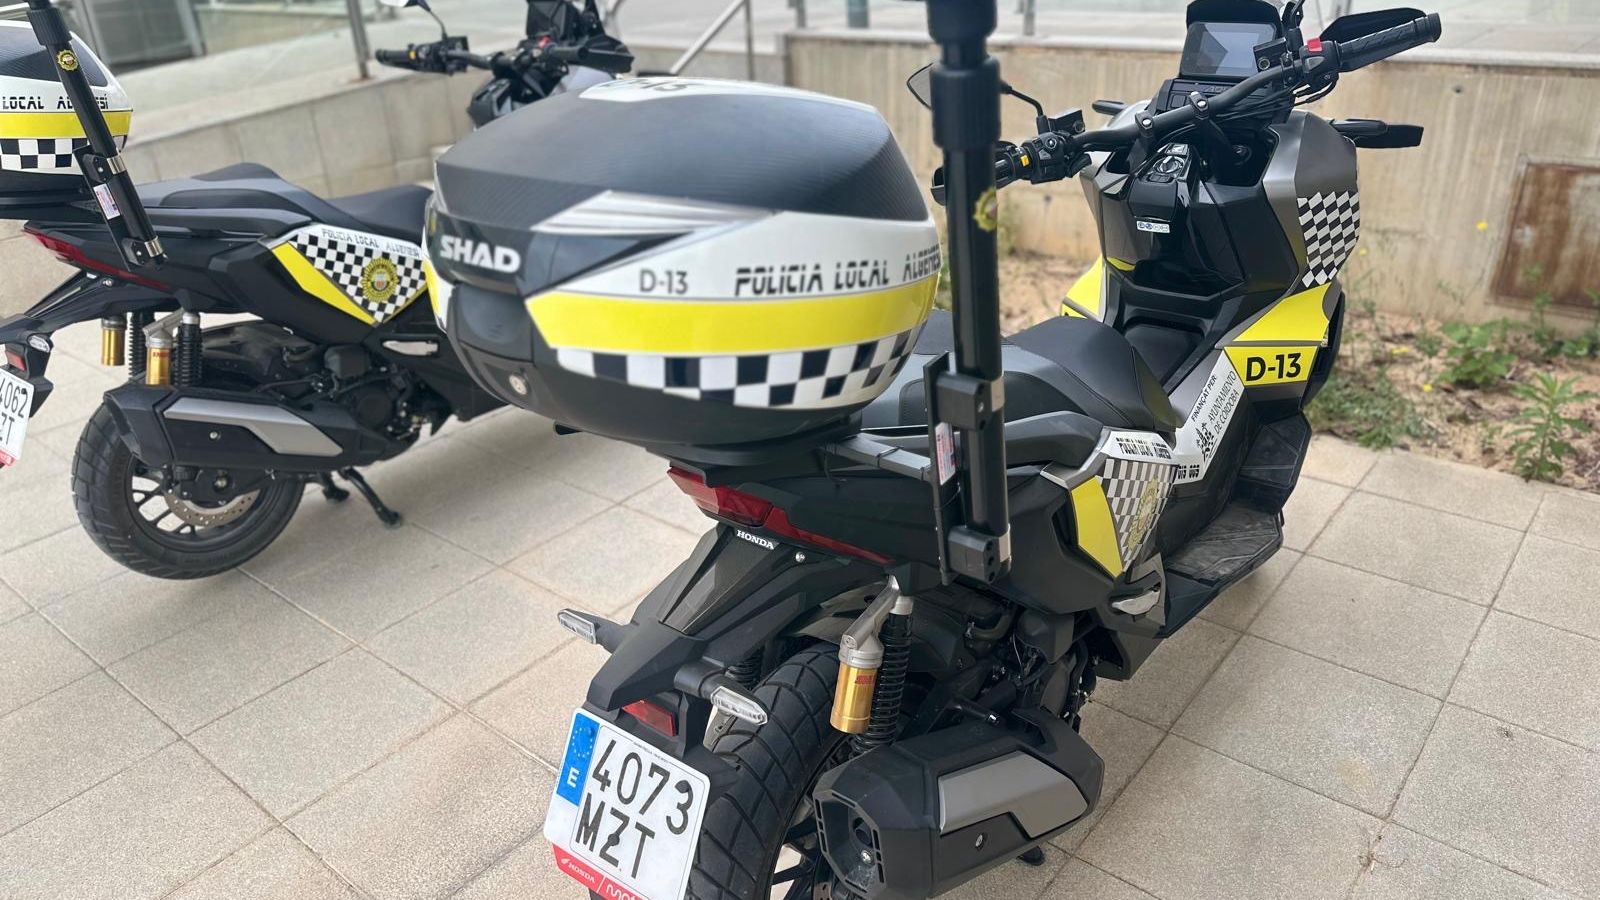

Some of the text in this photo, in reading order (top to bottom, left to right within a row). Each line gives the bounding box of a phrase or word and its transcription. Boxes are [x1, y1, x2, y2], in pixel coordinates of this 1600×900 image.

[3, 96, 44, 110] LOCAL
[440, 234, 521, 274] SHAD
[639, 268, 688, 295] D-13
[735, 263, 823, 297] POLICIA
[834, 259, 889, 290] LOCAL
[1245, 352, 1302, 382] D-13
[1207, 370, 1237, 422] AYUNTAMIENTO
[1214, 421, 1223, 435] DE
[736, 529, 775, 550] HONDA
[566, 766, 580, 788] E
[592, 739, 694, 835] 4073
[575, 792, 656, 880] MZT
[568, 862, 596, 884] HONDA
